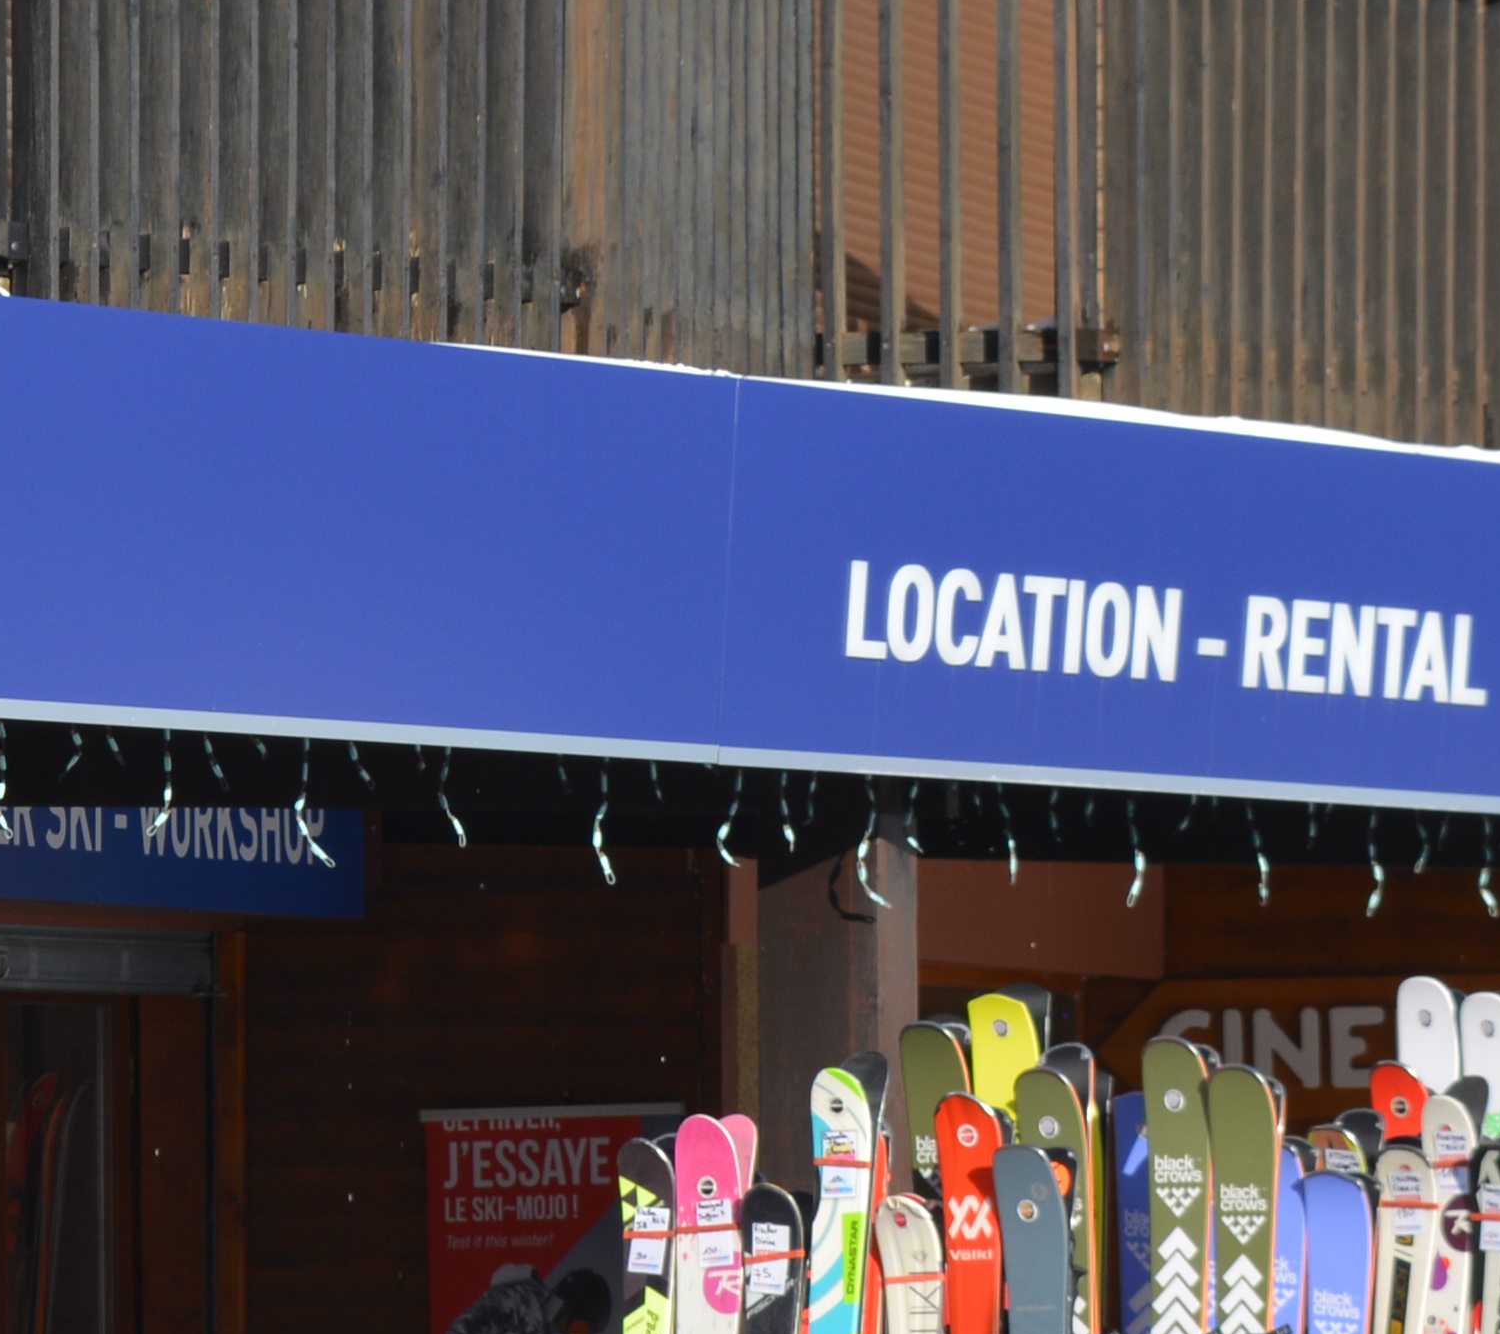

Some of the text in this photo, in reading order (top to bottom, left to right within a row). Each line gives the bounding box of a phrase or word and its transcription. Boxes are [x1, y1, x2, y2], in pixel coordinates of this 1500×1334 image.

[846, 560, 1181, 683] LOCATION
[1241, 596, 1487, 706] RENTAL
[45, 806, 102, 852] SKI
[915, 1135, 938, 1151] bla
[444, 1137, 612, 1189] J'ESSAYE
[1154, 1154, 1194, 1171] black
[1154, 1169, 1203, 1183] crows
[1220, 1183, 1259, 1200] black
[444, 1197, 467, 1223] LE
[1220, 1198, 1268, 1212] crows
[447, 1235, 471, 1249] Test
[474, 1235, 482, 1248] it
[485, 1233, 507, 1248] this
[846, 1219, 858, 1295] DYNASTAR
[950, 1249, 994, 1261] Völkl
[1313, 1289, 1353, 1306] black
[1313, 1303, 1361, 1319] crows
